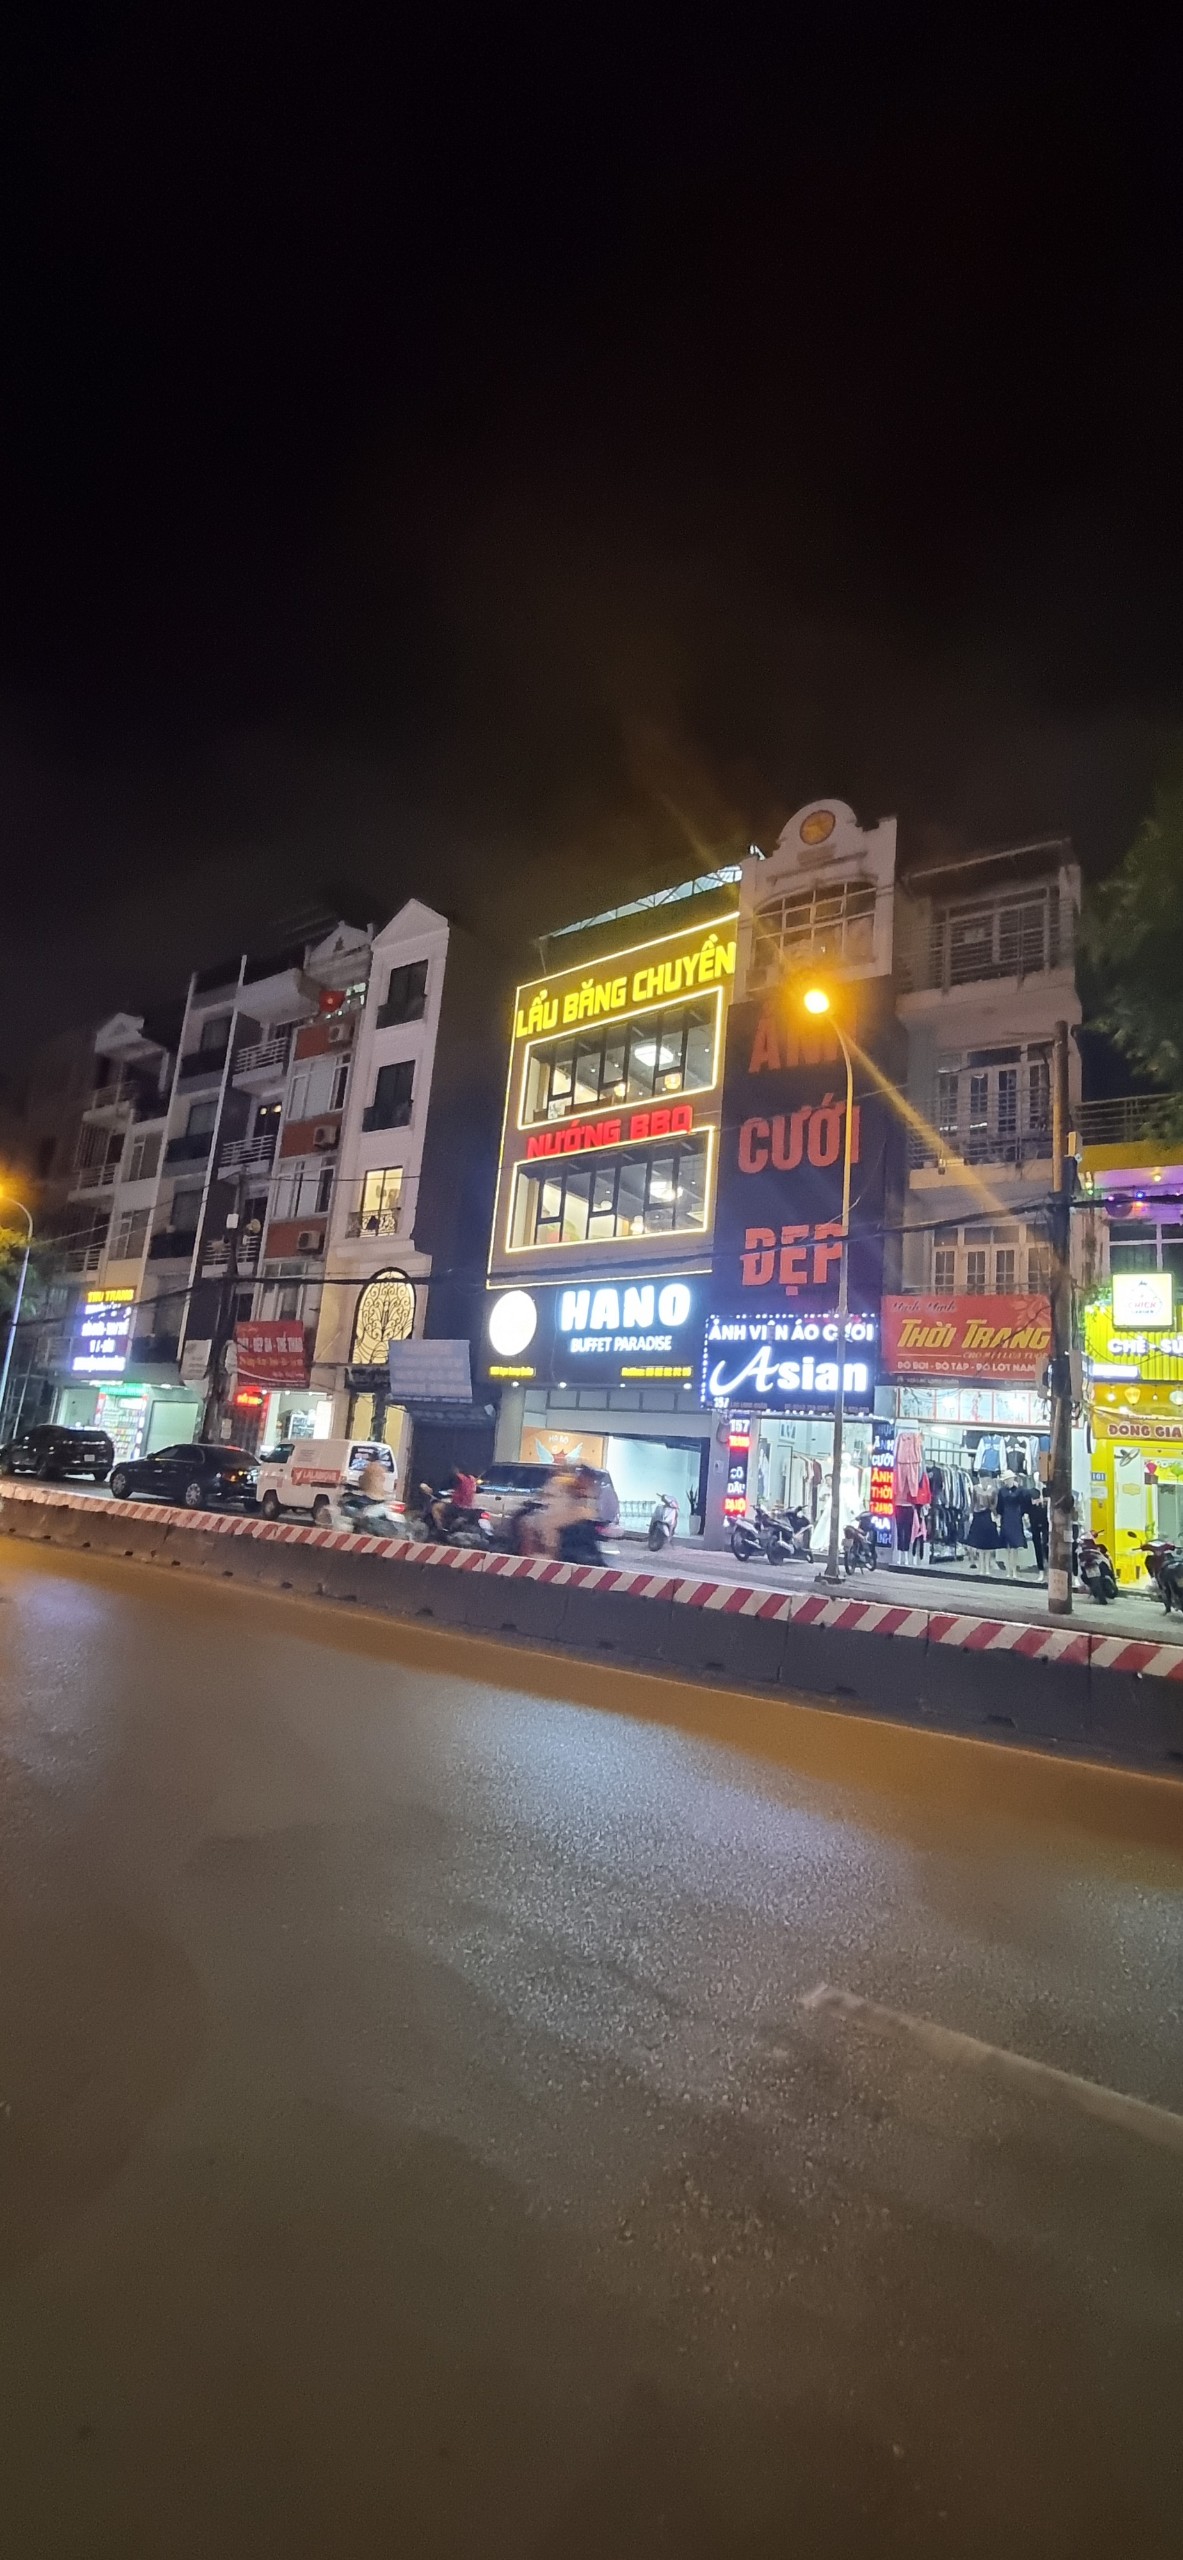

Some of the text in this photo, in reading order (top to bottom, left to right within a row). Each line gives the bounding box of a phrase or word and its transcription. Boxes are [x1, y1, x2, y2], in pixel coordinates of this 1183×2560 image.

[515, 933, 737, 1038] LẨU BĂNG CHUYỀN
[527, 1104, 694, 1160] NƯỚNG BBQ
[738, 1092, 862, 1174] CƯỚI
[740, 1222, 845, 1297] ĐẸP
[560, 1283, 692, 1332] HANO
[708, 1318, 747, 1340] ẢNH
[749, 1319, 789, 1342] VIN
[791, 1318, 820, 1341] ÁO
[570, 1335, 673, 1353] BUFFET PARADISE
[897, 1319, 1051, 1350] THỜI TRANG
[709, 1345, 868, 1397] Asian
[729, 1419, 750, 1432] 157
